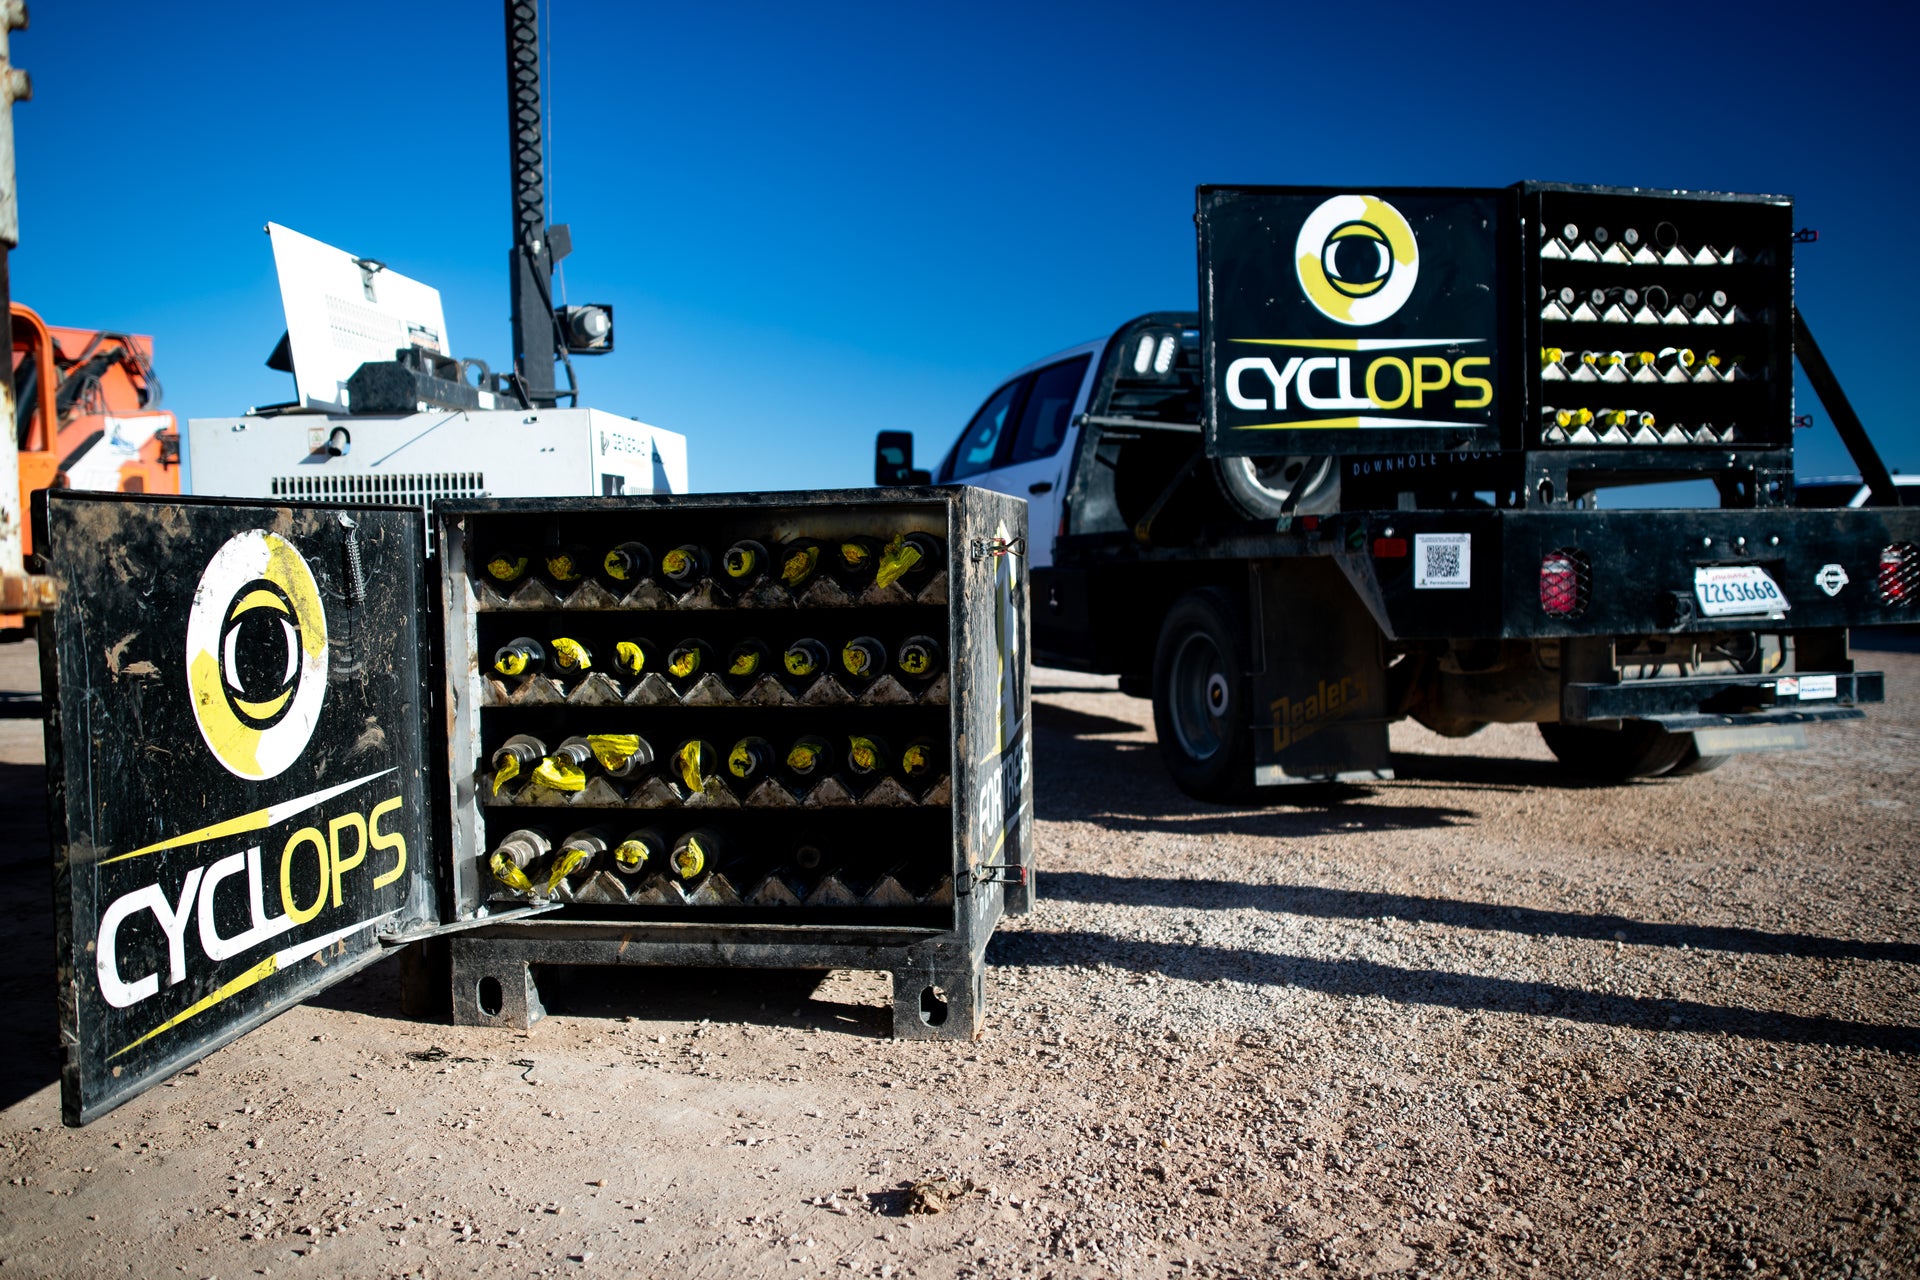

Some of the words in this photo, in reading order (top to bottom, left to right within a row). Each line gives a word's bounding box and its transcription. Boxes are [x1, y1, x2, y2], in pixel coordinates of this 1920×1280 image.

[1226, 356, 1493, 410] CYCLOPS
[1353, 453, 1437, 476] DOWNHOLE
[1698, 581, 1778, 603] Z263668
[97, 795, 407, 1008] CYCLOPS
